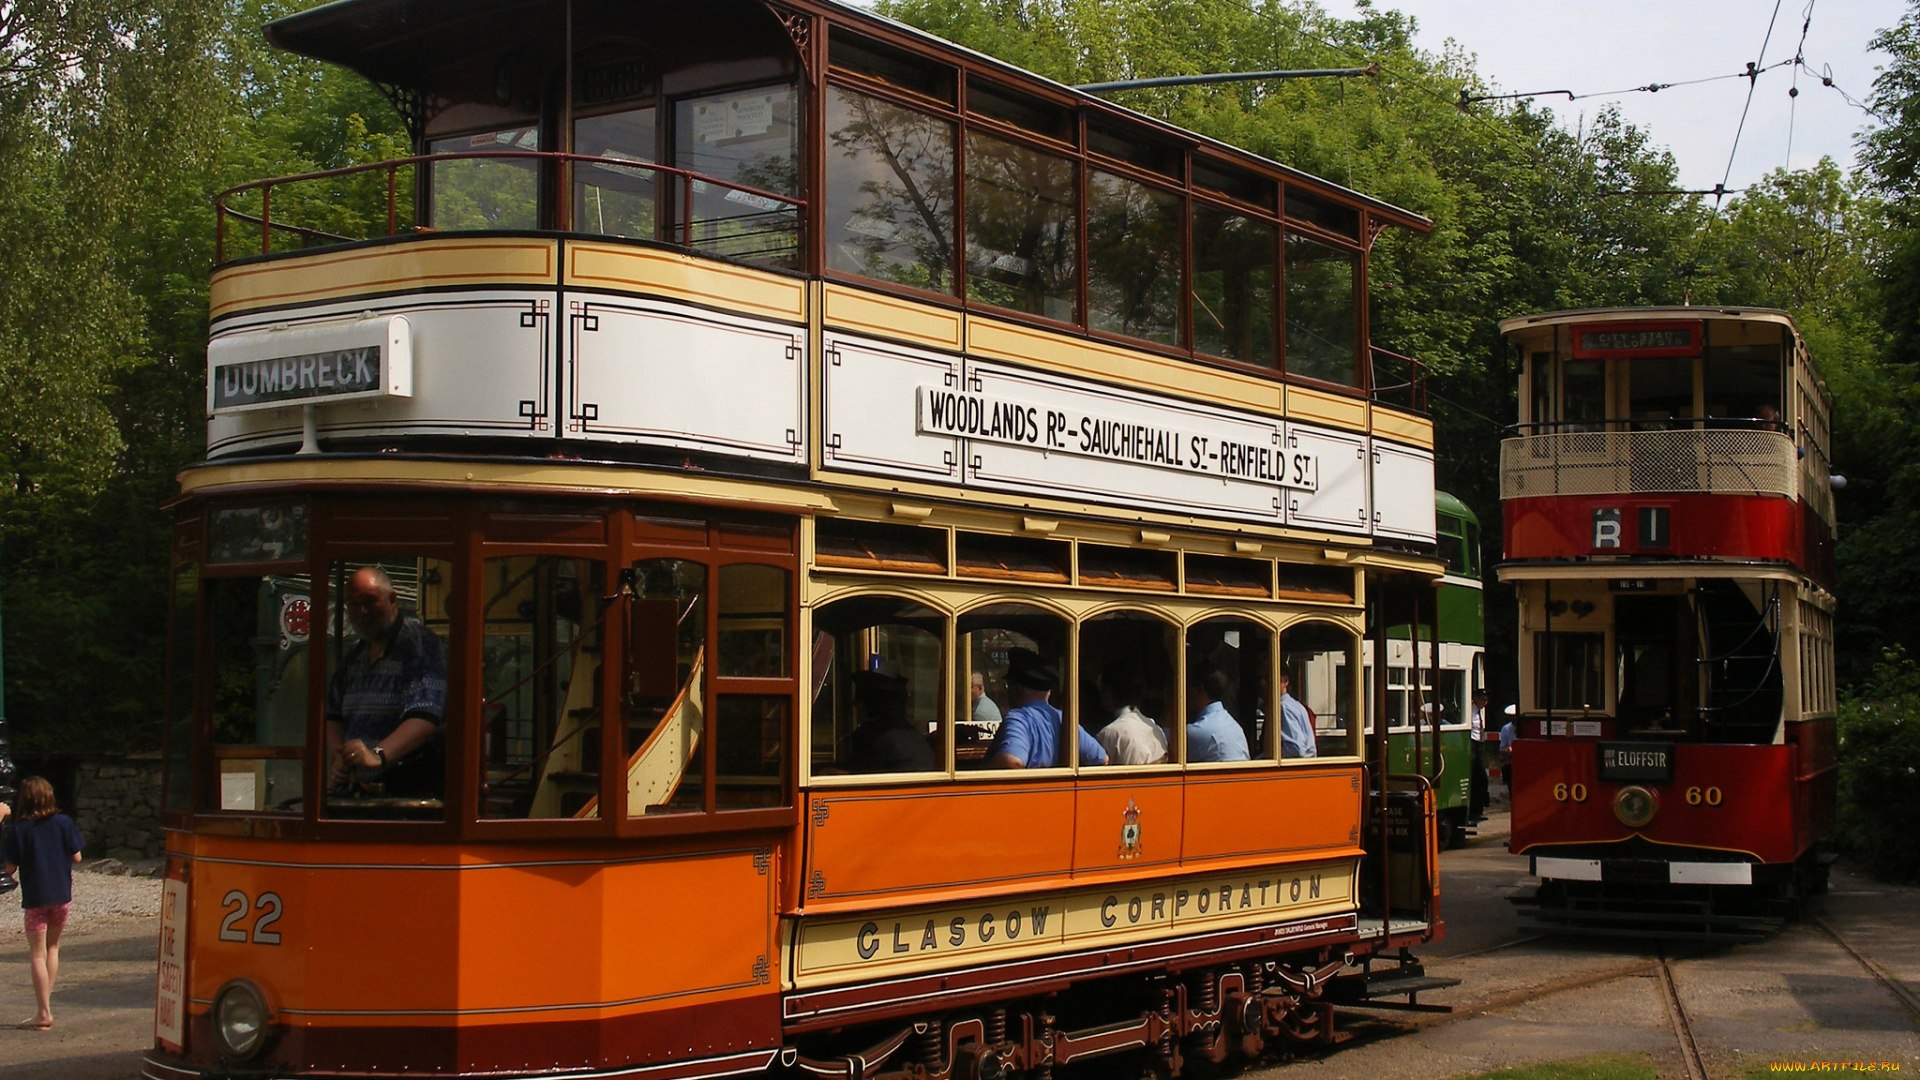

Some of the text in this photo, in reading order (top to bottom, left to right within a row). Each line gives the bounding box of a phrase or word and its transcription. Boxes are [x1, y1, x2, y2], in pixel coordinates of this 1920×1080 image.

[223, 349, 373, 398] DUMBRECK
[930, 390, 1038, 443] WOODLANDS
[1618, 751, 1667, 767] ELOFFSTR
[1553, 782, 1587, 801] 60
[1685, 786, 1722, 806] 60
[1374, 807, 1403, 816] PASE
[219, 889, 283, 945] 22
[857, 874, 1322, 960] GLASGOW CORPORATION
